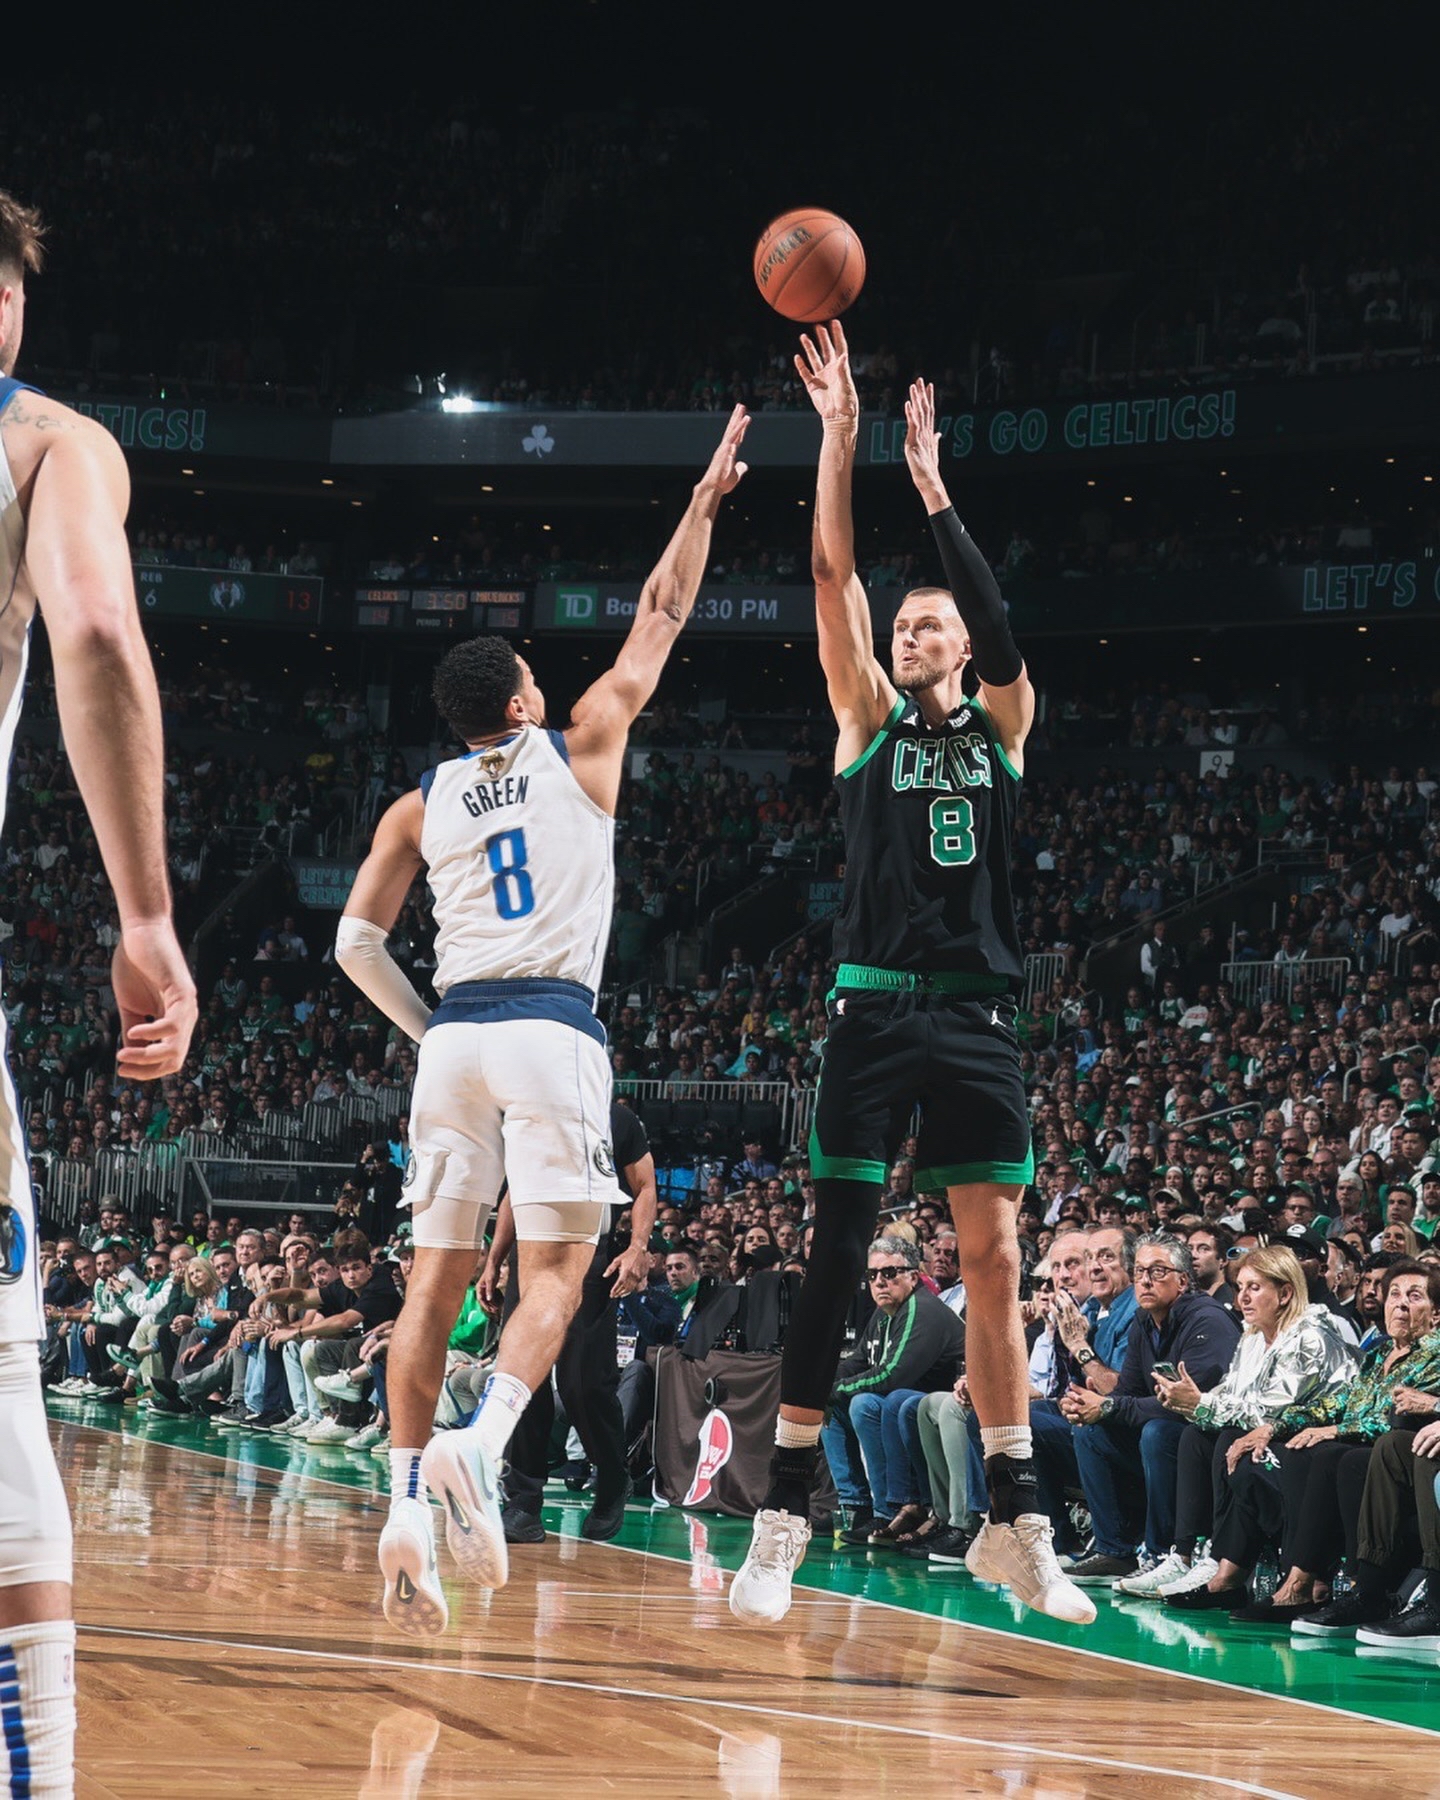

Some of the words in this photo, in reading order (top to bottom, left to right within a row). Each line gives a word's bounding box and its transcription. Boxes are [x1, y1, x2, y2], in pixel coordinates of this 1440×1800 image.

[67, 402, 206, 452] TICS!
[870, 415, 974, 464] LE'S
[990, 408, 1049, 455] GO
[1065, 390, 1237, 448] CELTICS!
[140, 571, 163, 584] REB
[145, 589, 157, 608] 6
[1303, 561, 1418, 612] LET'S
[287, 590, 312, 611] 13
[560, 593, 593, 617] TD
[606, 597, 637, 616] Ba
[689, 598, 733, 620] :30
[741, 598, 778, 620] PM
[462, 775, 530, 818] GREEN
[929, 796, 975, 868] 8
[485, 827, 535, 920] 8
